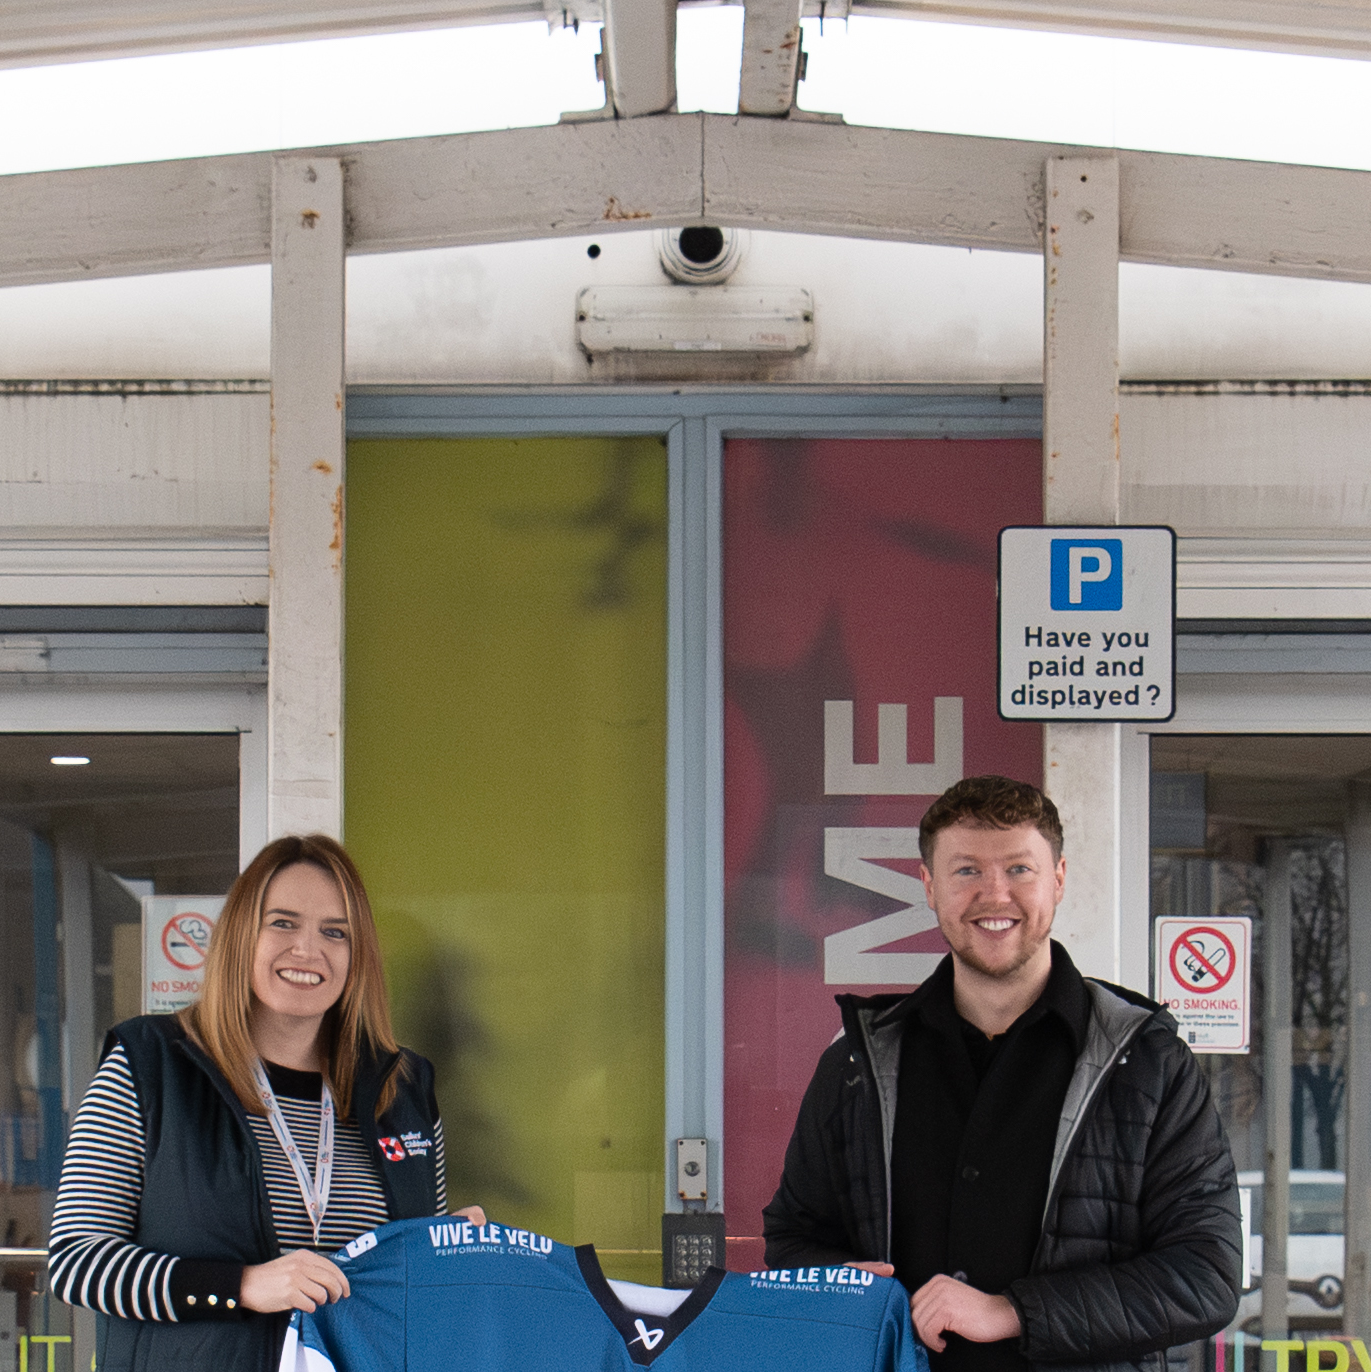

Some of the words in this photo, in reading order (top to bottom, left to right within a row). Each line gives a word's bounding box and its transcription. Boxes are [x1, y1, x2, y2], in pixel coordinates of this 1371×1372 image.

[1068, 546, 1112, 604] P
[1024, 626, 1091, 648] Have
[1102, 632, 1149, 652] you
[1028, 655, 1085, 680] paid
[1095, 655, 1144, 677] and
[151, 981, 170, 994] NO
[428, 1221, 474, 1248] VIVE
[479, 1223, 502, 1244] LE
[435, 1245, 505, 1257] PERFORMANCE
[796, 1267, 821, 1283] LE
[750, 1280, 821, 1293] PERFORMANCE
[823, 1284, 865, 1296] CYCLING
